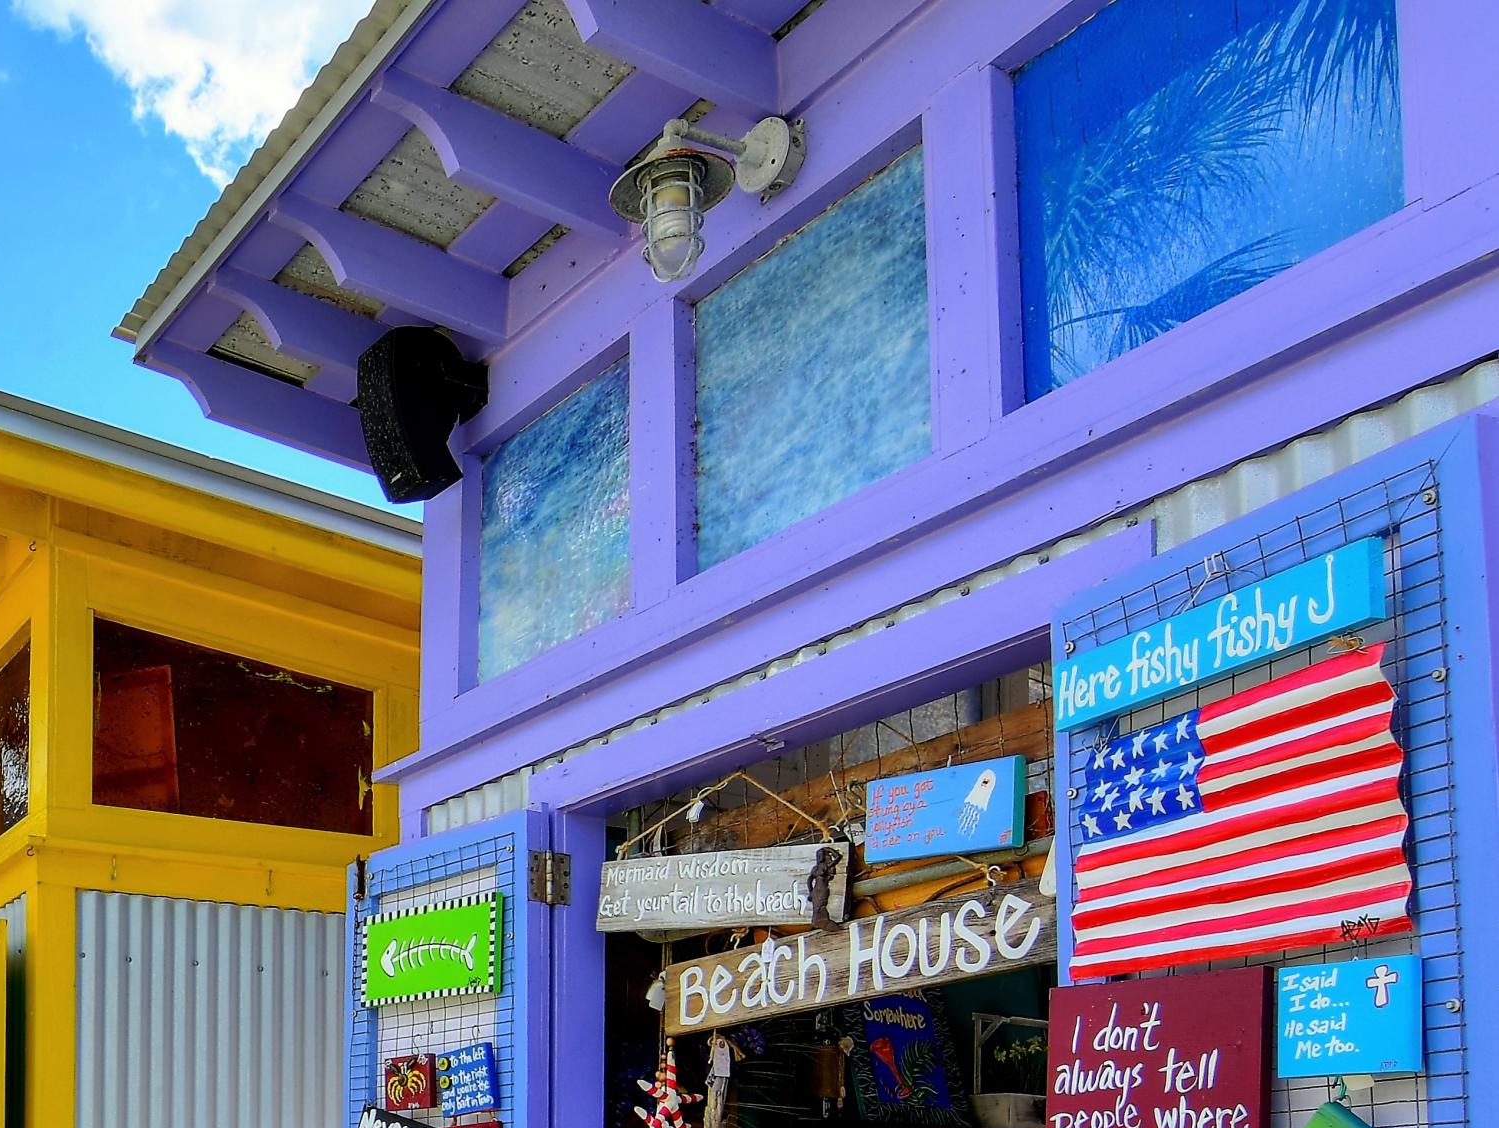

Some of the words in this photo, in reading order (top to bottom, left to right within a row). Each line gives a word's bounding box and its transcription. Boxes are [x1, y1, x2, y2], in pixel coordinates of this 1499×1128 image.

[1058, 662, 1122, 720] Here
[1127, 622, 1199, 696] fishy
[1207, 587, 1298, 669] fishy
[606, 860, 669, 888] Mermaid
[599, 890, 631, 918] Get
[636, 893, 671, 922] your
[671, 884, 700, 914] tail
[703, 887, 723, 914] to
[723, 883, 755, 913] the
[754, 879, 808, 916] beach
[1282, 973, 1300, 992] I
[1299, 967, 1338, 993] said
[1289, 993, 1307, 1013] I
[1071, 1015, 1081, 1054] I
[1093, 1001, 1162, 1052] don't
[1284, 1019, 1305, 1039] He
[1306, 1012, 1347, 1036] said
[449, 1054, 458, 1068] to
[459, 1050, 472, 1065] the
[1294, 1039, 1322, 1060] Me
[449, 1073, 458, 1086] to
[459, 1069, 471, 1085] the
[1054, 1059, 1144, 1102] always
[1158, 1047, 1219, 1094] tell
[442, 1087, 455, 1100] and
